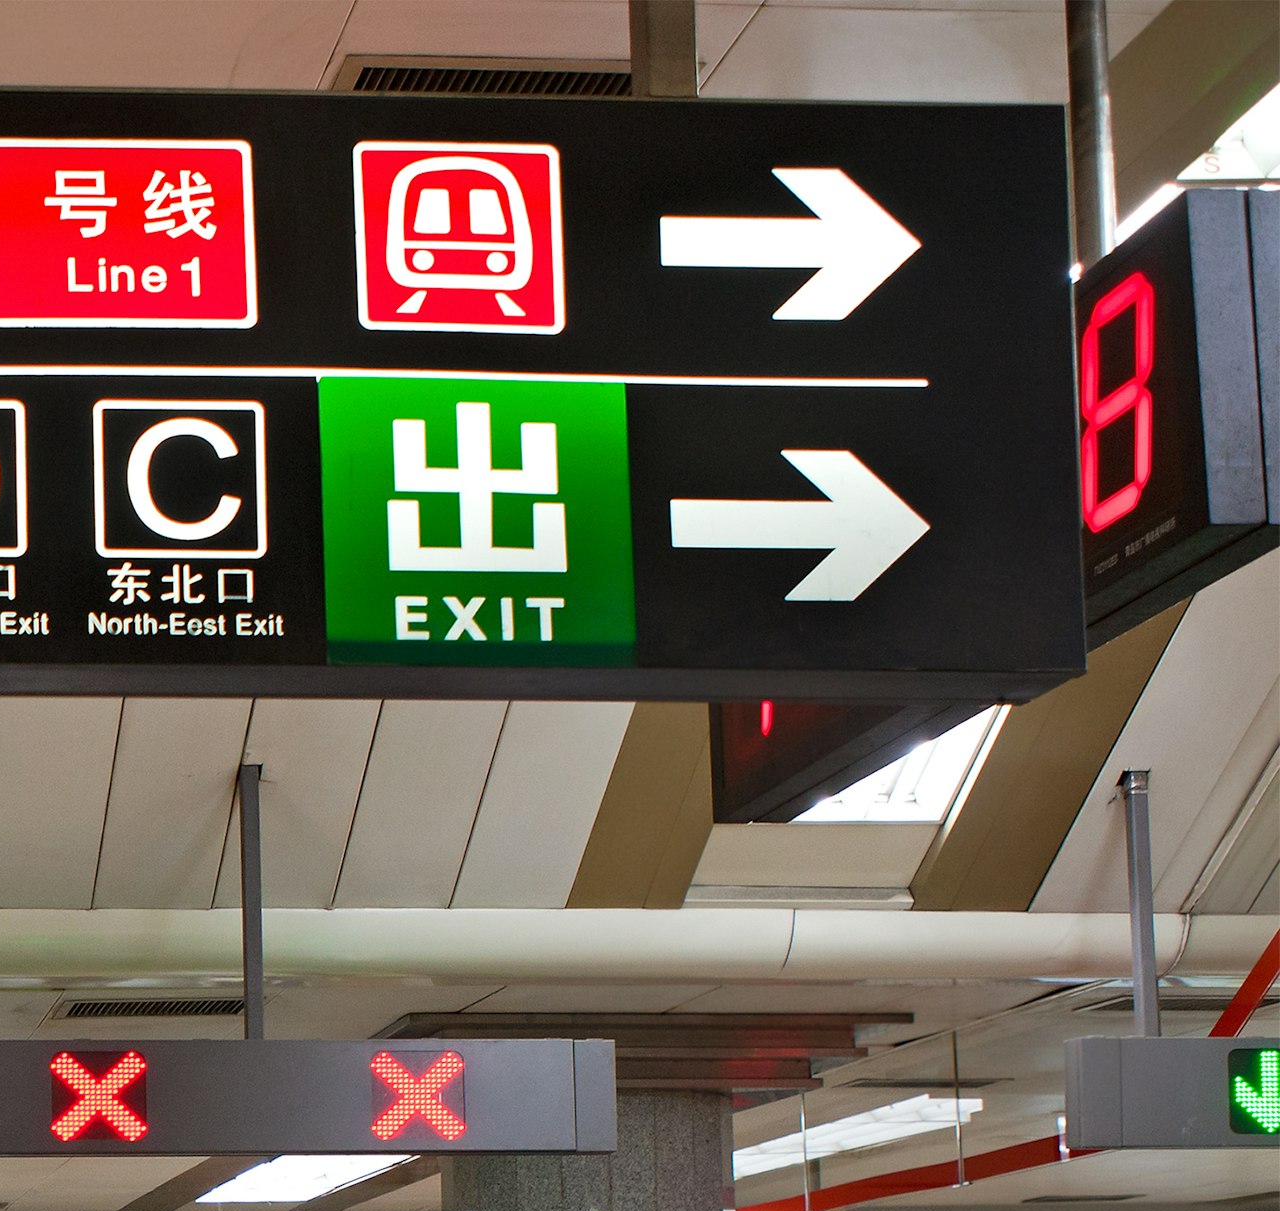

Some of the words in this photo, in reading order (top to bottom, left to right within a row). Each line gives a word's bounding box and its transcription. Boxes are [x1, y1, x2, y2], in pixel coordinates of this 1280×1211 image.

[44, 169, 217, 240] 号线
[67, 256, 168, 293] Line
[180, 257, 202, 297] 1
[127, 418, 241, 541] C
[387, 402, 568, 573] 出
[106, 562, 254, 606] 东北口
[0, 611, 50, 636] Exit
[236, 613, 285, 637] Exit
[395, 595, 565, 642] EXIT
